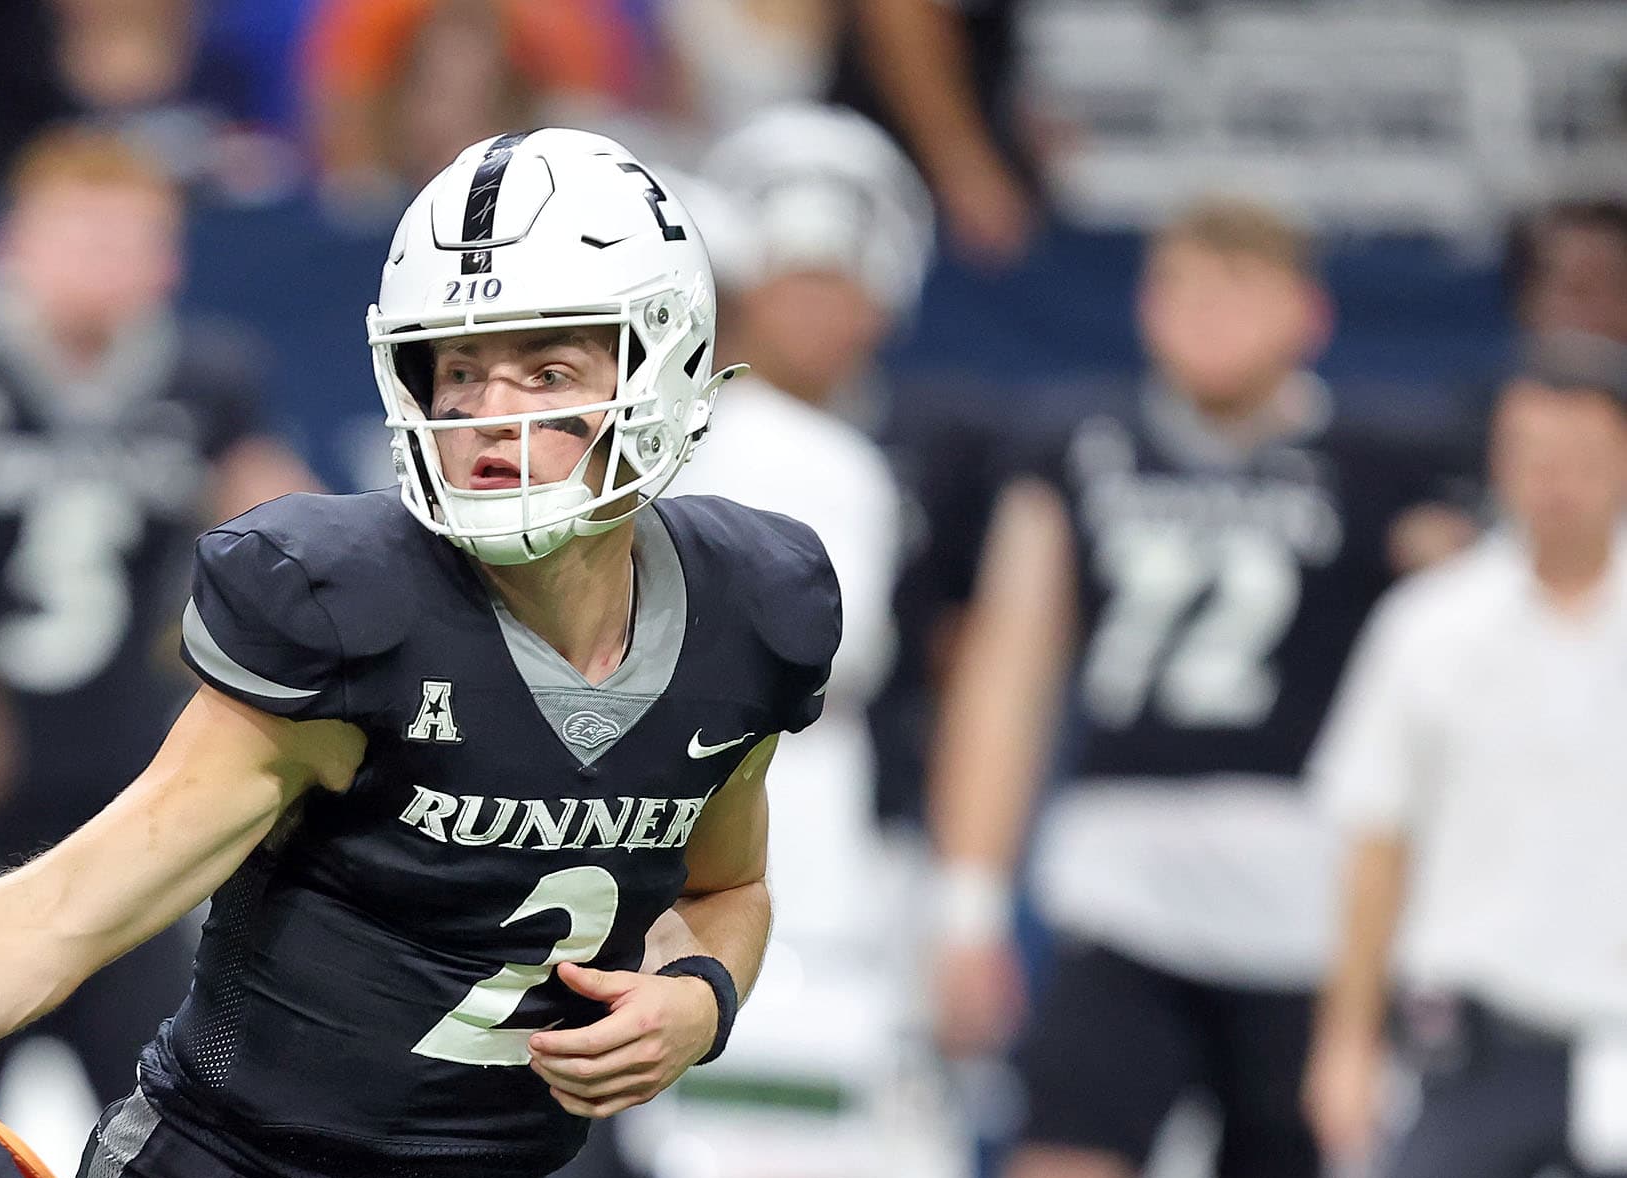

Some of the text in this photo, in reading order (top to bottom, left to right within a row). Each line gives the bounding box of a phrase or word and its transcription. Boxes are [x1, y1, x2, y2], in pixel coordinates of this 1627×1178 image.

[620, 162, 687, 242] 2
[442, 277, 503, 306] 210
[398, 784, 718, 851] RUNNER
[410, 865, 620, 1067] 2
